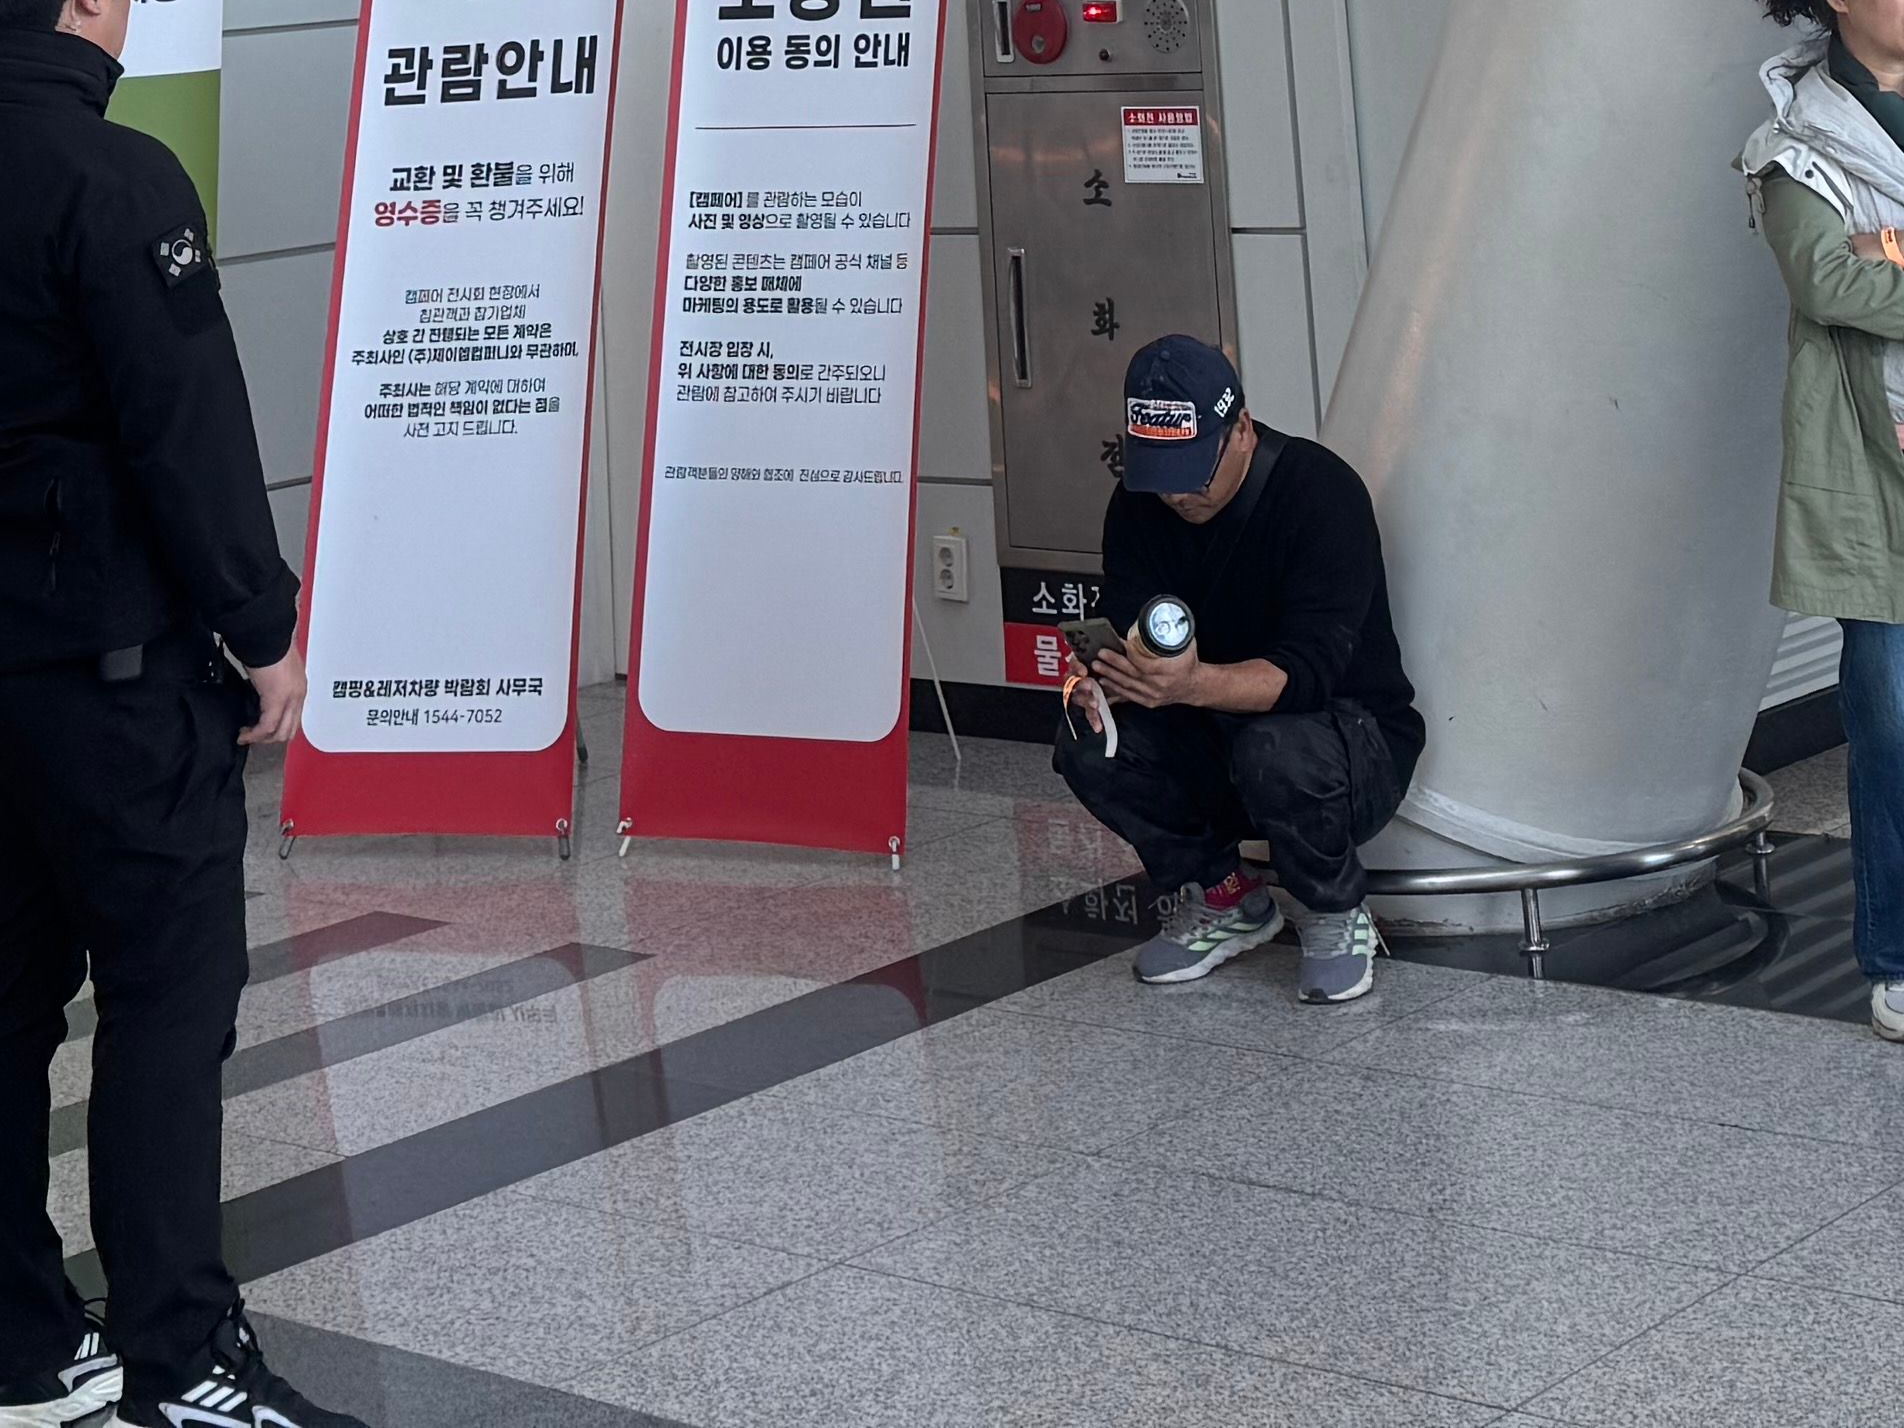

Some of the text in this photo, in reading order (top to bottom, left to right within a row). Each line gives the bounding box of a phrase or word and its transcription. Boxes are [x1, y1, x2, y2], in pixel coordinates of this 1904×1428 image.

[717, 32, 910, 71] 이용 동의 안내
[383, 34, 598, 106] 관람안내
[390, 160, 575, 192] 교환 및 환불을 위해
[763, 191, 817, 208] 관람하는
[820, 191, 862, 208] 모습이
[374, 195, 584, 227] 영수증을 꼭 챙겨주세요!
[688, 212, 717, 230] 사진
[721, 213, 734, 230] 및
[738, 212, 792, 230] 영상으로
[841, 212, 855, 230] 수
[858, 212, 911, 229] 있습니다
[732, 253, 786, 271] 콘텐츠는
[834, 253, 862, 270] 공식
[865, 253, 893, 270] 채널
[684, 275, 727, 292] 다양한
[731, 275, 757, 292] 홍보
[682, 297, 739, 314] 마케팅의
[742, 297, 783, 314] 용도로
[832, 298, 846, 315] 수
[849, 297, 903, 315] 있습니다
[383, 329, 408, 345] 상호
[412, 328, 426, 343] 간
[483, 324, 509, 341] 모든
[513, 322, 552, 339] 계약은
[352, 348, 404, 366] 주최사인
[679, 340, 774, 359] 전시장 입장 시,
[677, 362, 886, 382] 위 사항에 대한 동의로 간주되오니
[379, 381, 431, 399] 주최사는
[676, 385, 882, 405] 관람에 참고하여 주시기 바랍니다
[364, 402, 403, 419] 어떠한
[449, 399, 488, 416] 책임이
[403, 421, 429, 438] 사전
[432, 421, 459, 437] 고지
[332, 677, 544, 699] 캠핑&레저차량 박람회 사무국
[366, 708, 502, 727] 문의안내 1544-7052
